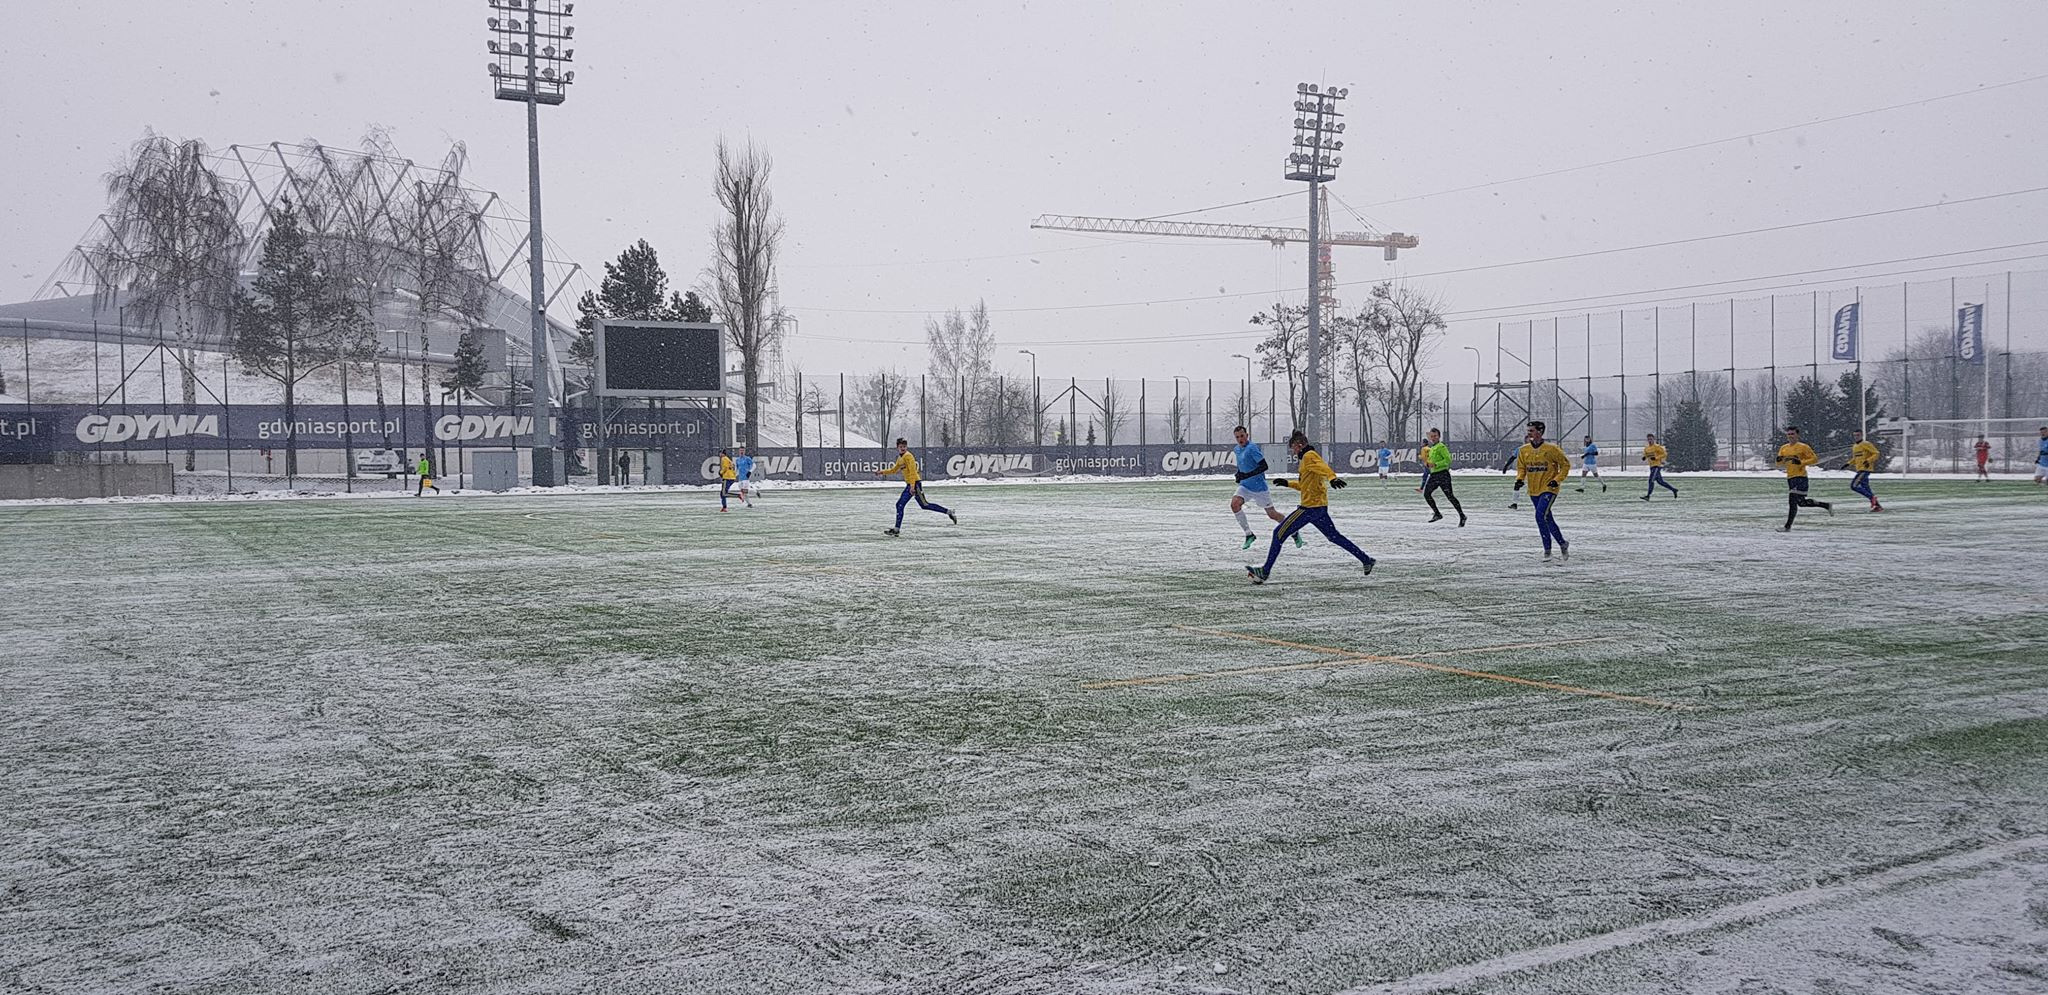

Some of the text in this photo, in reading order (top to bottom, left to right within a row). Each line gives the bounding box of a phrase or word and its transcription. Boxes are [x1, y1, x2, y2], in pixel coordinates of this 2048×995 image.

[75, 414, 219, 443] GDYNIA
[258, 417, 400, 440] gdyniasport.pl
[434, 414, 557, 441] GDYNI
[700, 455, 803, 480] GNIA
[946, 453, 1033, 477] GDYNIA
[1055, 453, 1141, 472] gdyniasport.pl
[1161, 451, 1238, 472] GDYNIA
[1349, 448, 1417, 469] GDNIA
